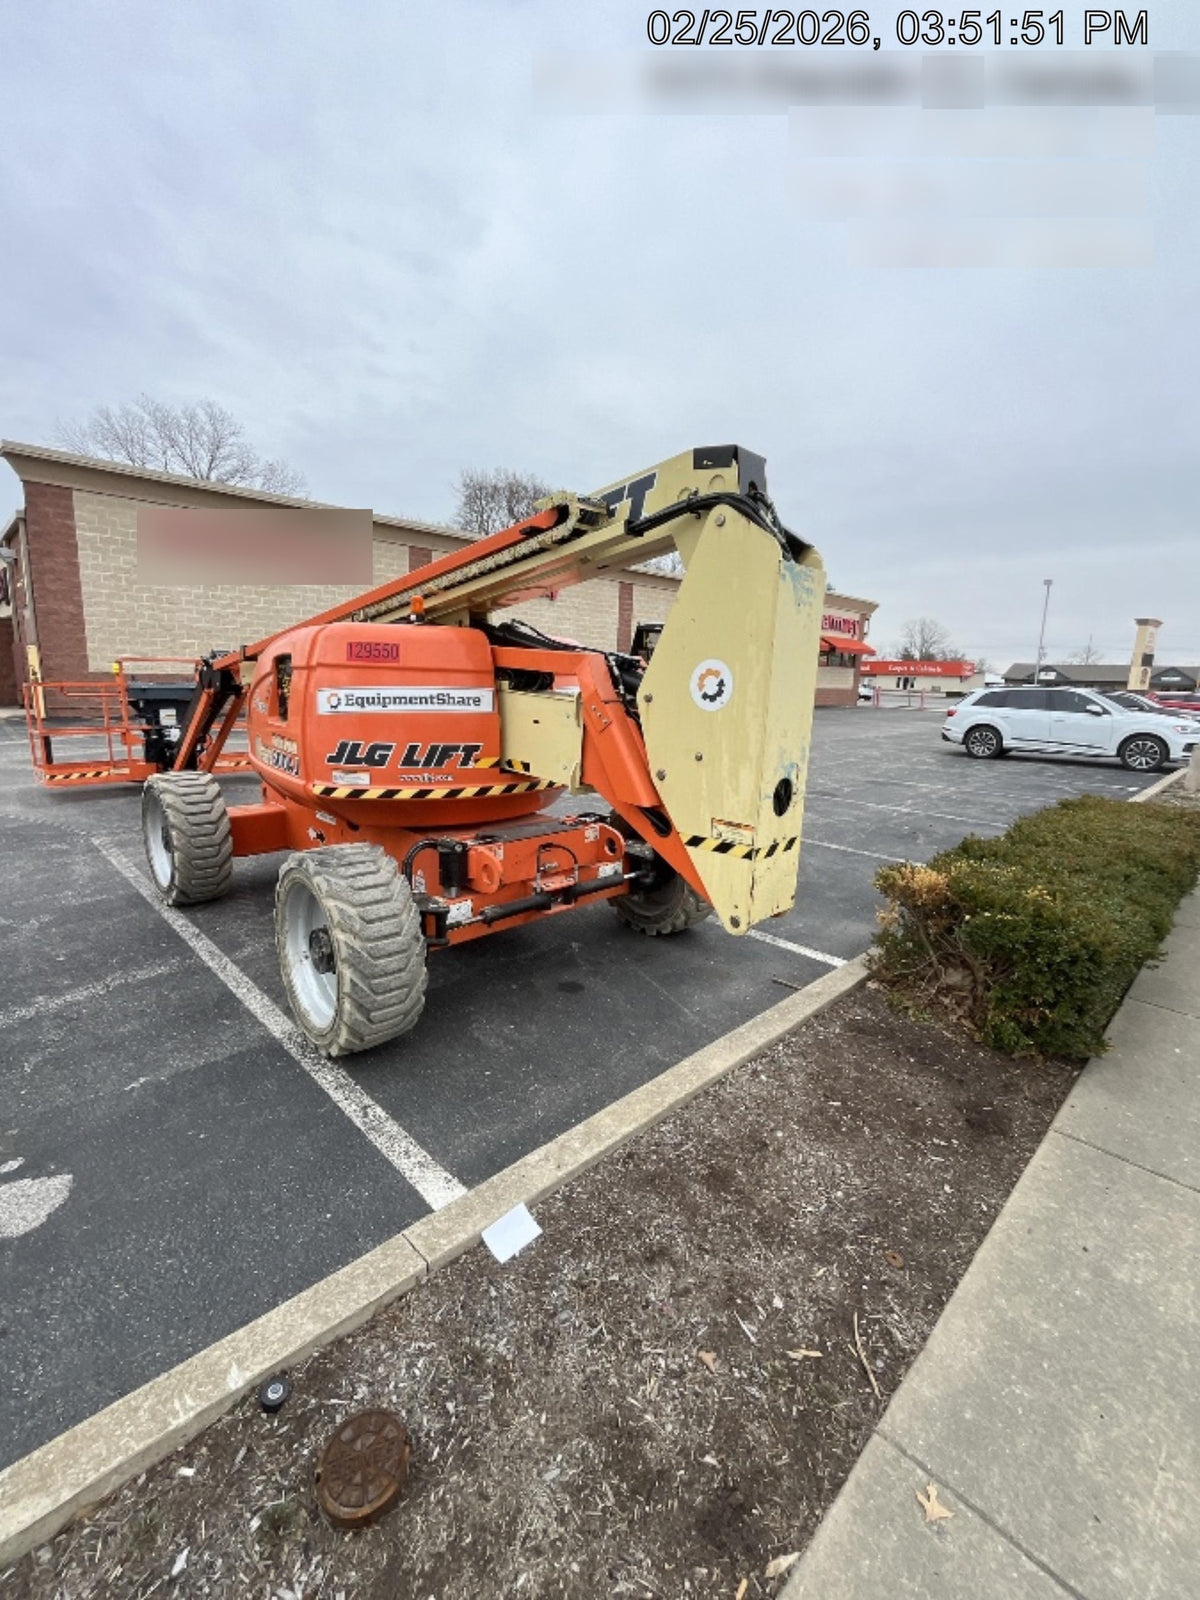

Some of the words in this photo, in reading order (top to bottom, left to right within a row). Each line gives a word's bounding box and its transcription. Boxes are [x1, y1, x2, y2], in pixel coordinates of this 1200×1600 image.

[348, 643, 399, 660] 129550
[344, 692, 482, 708] EquipmentShare
[326, 740, 396, 767] JLG
[398, 741, 484, 768] LIFT
